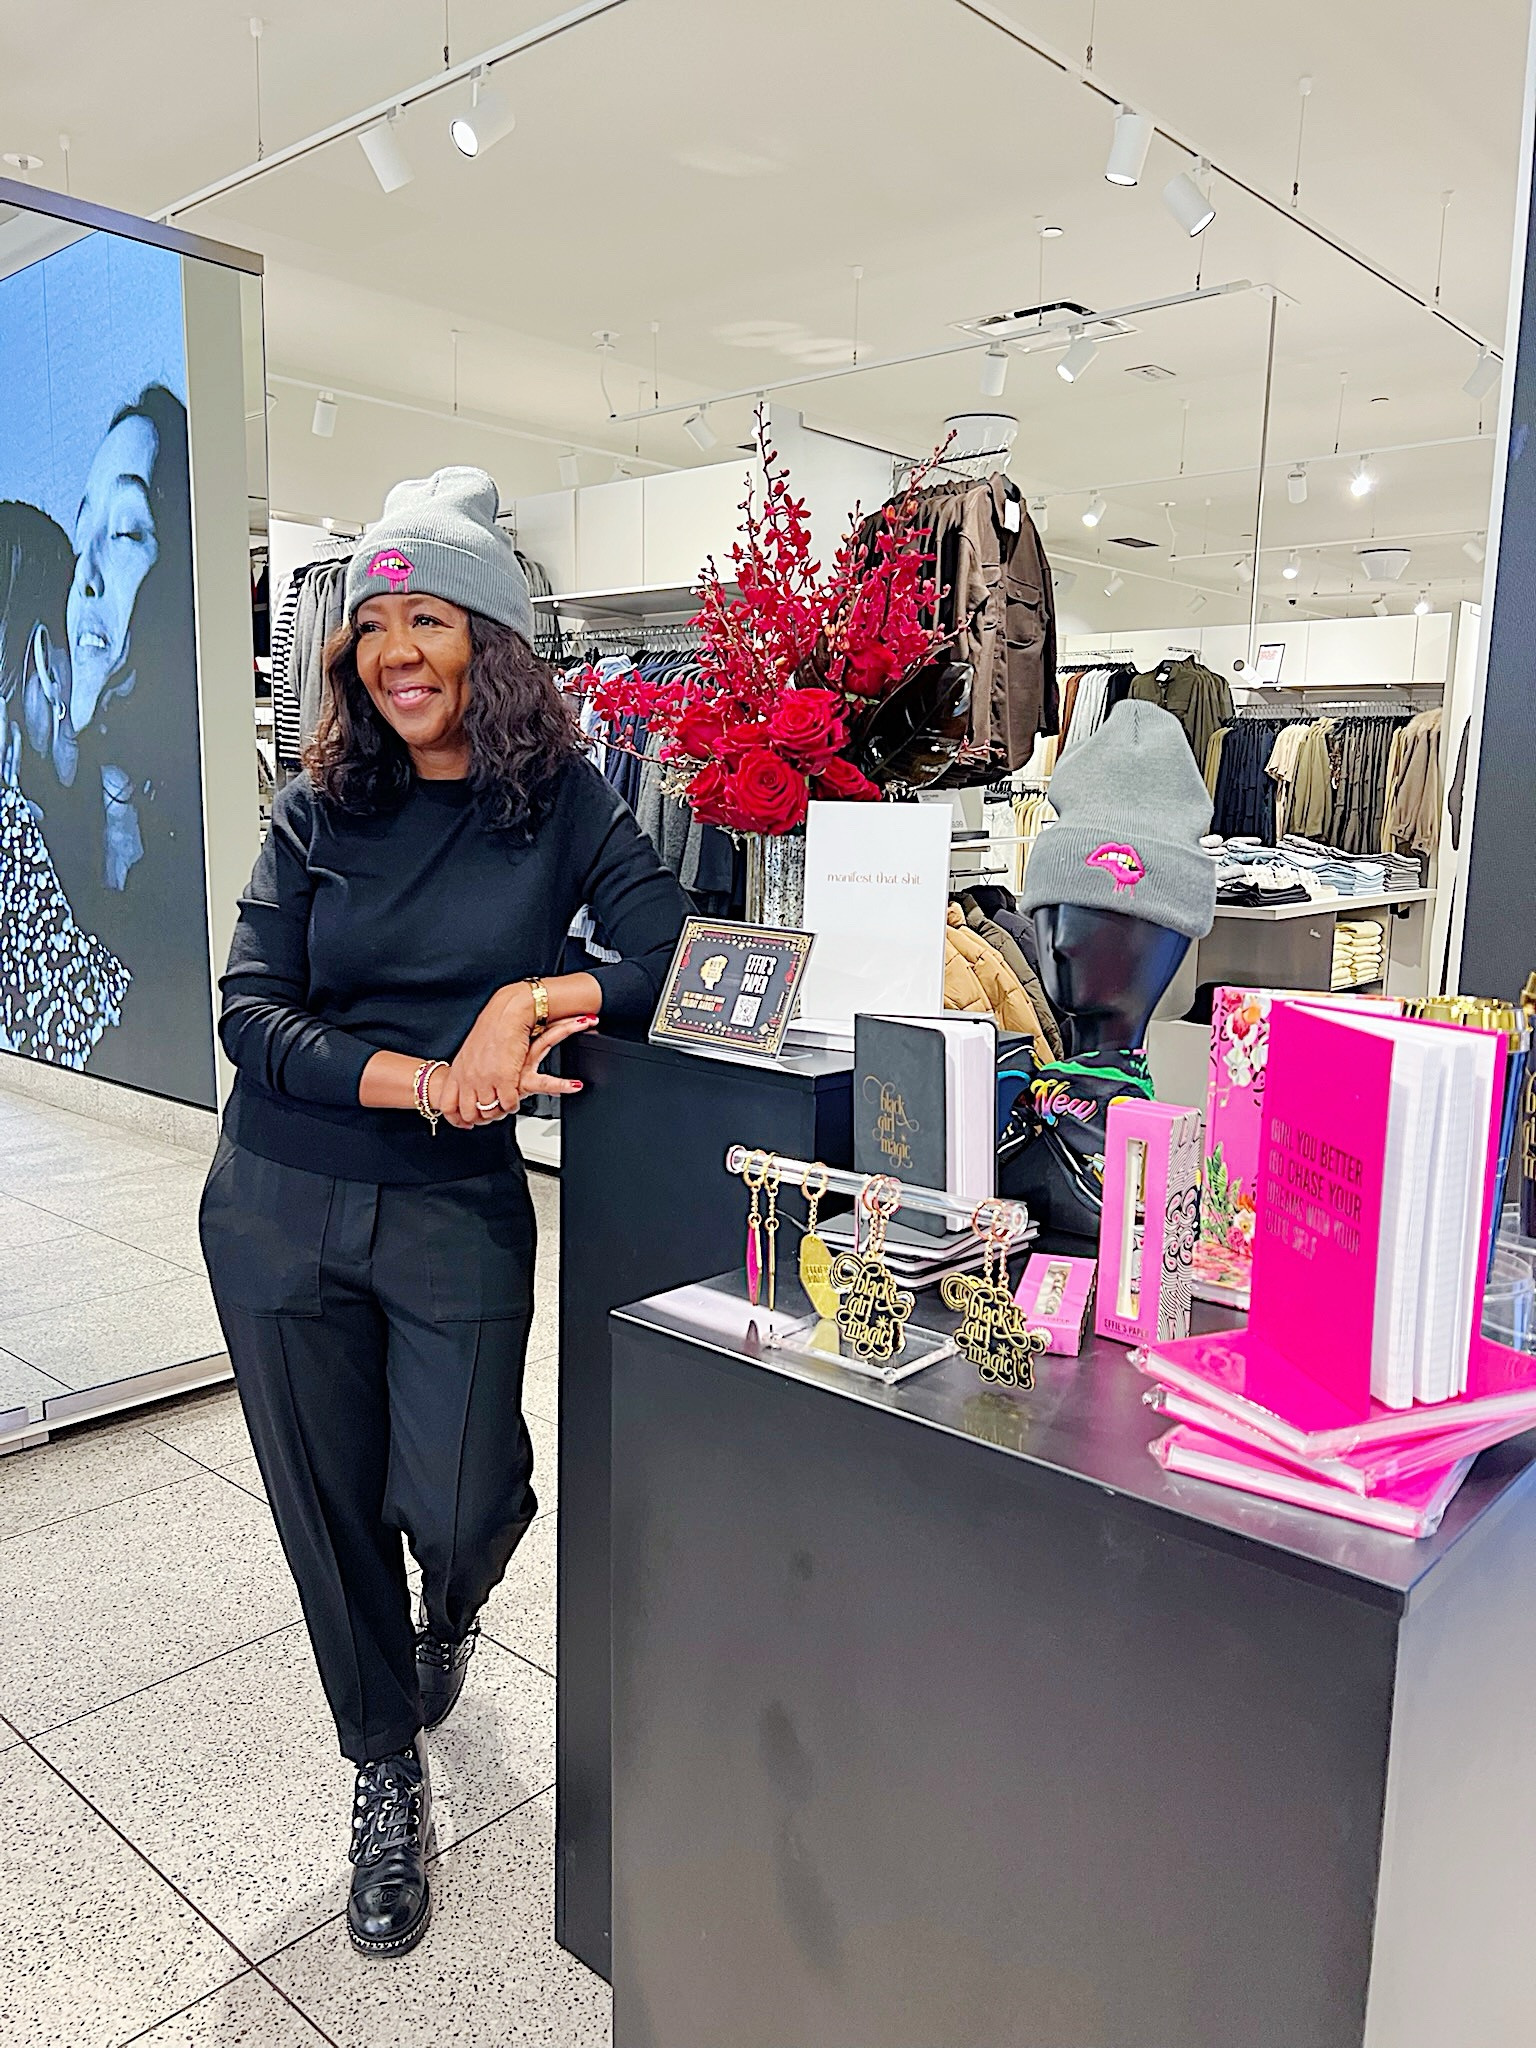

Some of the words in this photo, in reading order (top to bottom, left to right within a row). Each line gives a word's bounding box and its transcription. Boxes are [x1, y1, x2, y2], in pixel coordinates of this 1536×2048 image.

[827, 871, 872, 883] manifest
[876, 871, 898, 884] that
[745, 953, 777, 976] EFFIE'S
[740, 973, 769, 995] PAPER
[1030, 1079, 1098, 1126] New
[881, 1136, 913, 1168] magic
[1270, 1117, 1292, 1151] GIRL
[1297, 1129, 1318, 1162] YOU
[1320, 1141, 1362, 1188] BETTER
[1268, 1148, 1284, 1177] GO
[1288, 1159, 1324, 1200] CHASE
[1329, 1180, 1361, 1224] YOUR
[1266, 1179, 1304, 1222] DREAMS
[1333, 1219, 1360, 1256] YOUR
[838, 1294, 873, 1325] girl
[1103, 1318, 1127, 1333] EFFIE'S
[845, 1315, 891, 1355] magic
[956, 1319, 991, 1350] girl
[967, 1343, 1014, 1384] magic
